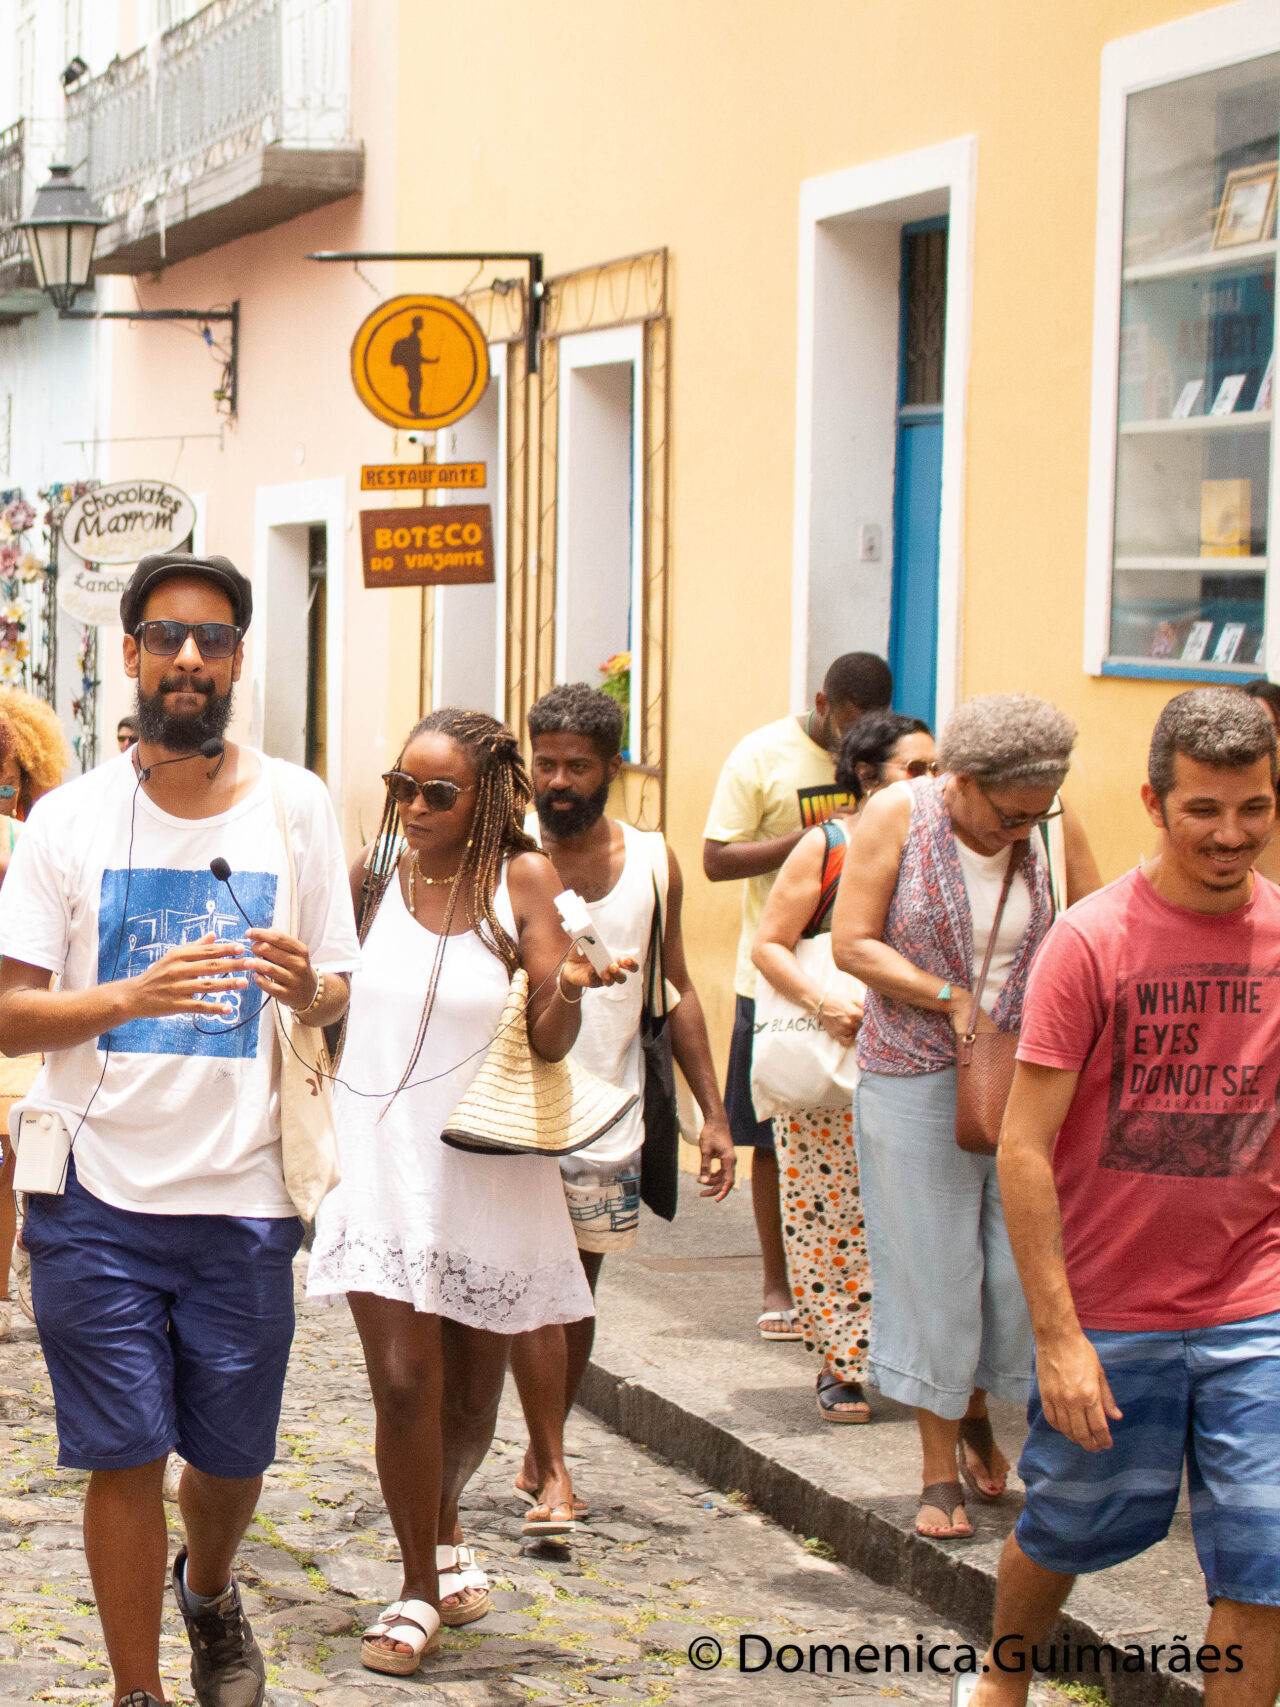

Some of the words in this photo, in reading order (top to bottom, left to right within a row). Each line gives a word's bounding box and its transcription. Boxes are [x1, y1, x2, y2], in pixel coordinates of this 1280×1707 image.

[74, 511, 173, 544] Marrom
[375, 522, 482, 550] BOTECO
[372, 557, 393, 571] DO
[406, 551, 484, 571] VIAJANTE
[74, 572, 127, 593] Lanch
[1136, 980, 1211, 1015] WHAT
[1216, 980, 1263, 1014] THE
[1134, 1023, 1200, 1056] EYES
[1222, 1065, 1265, 1097] SEE
